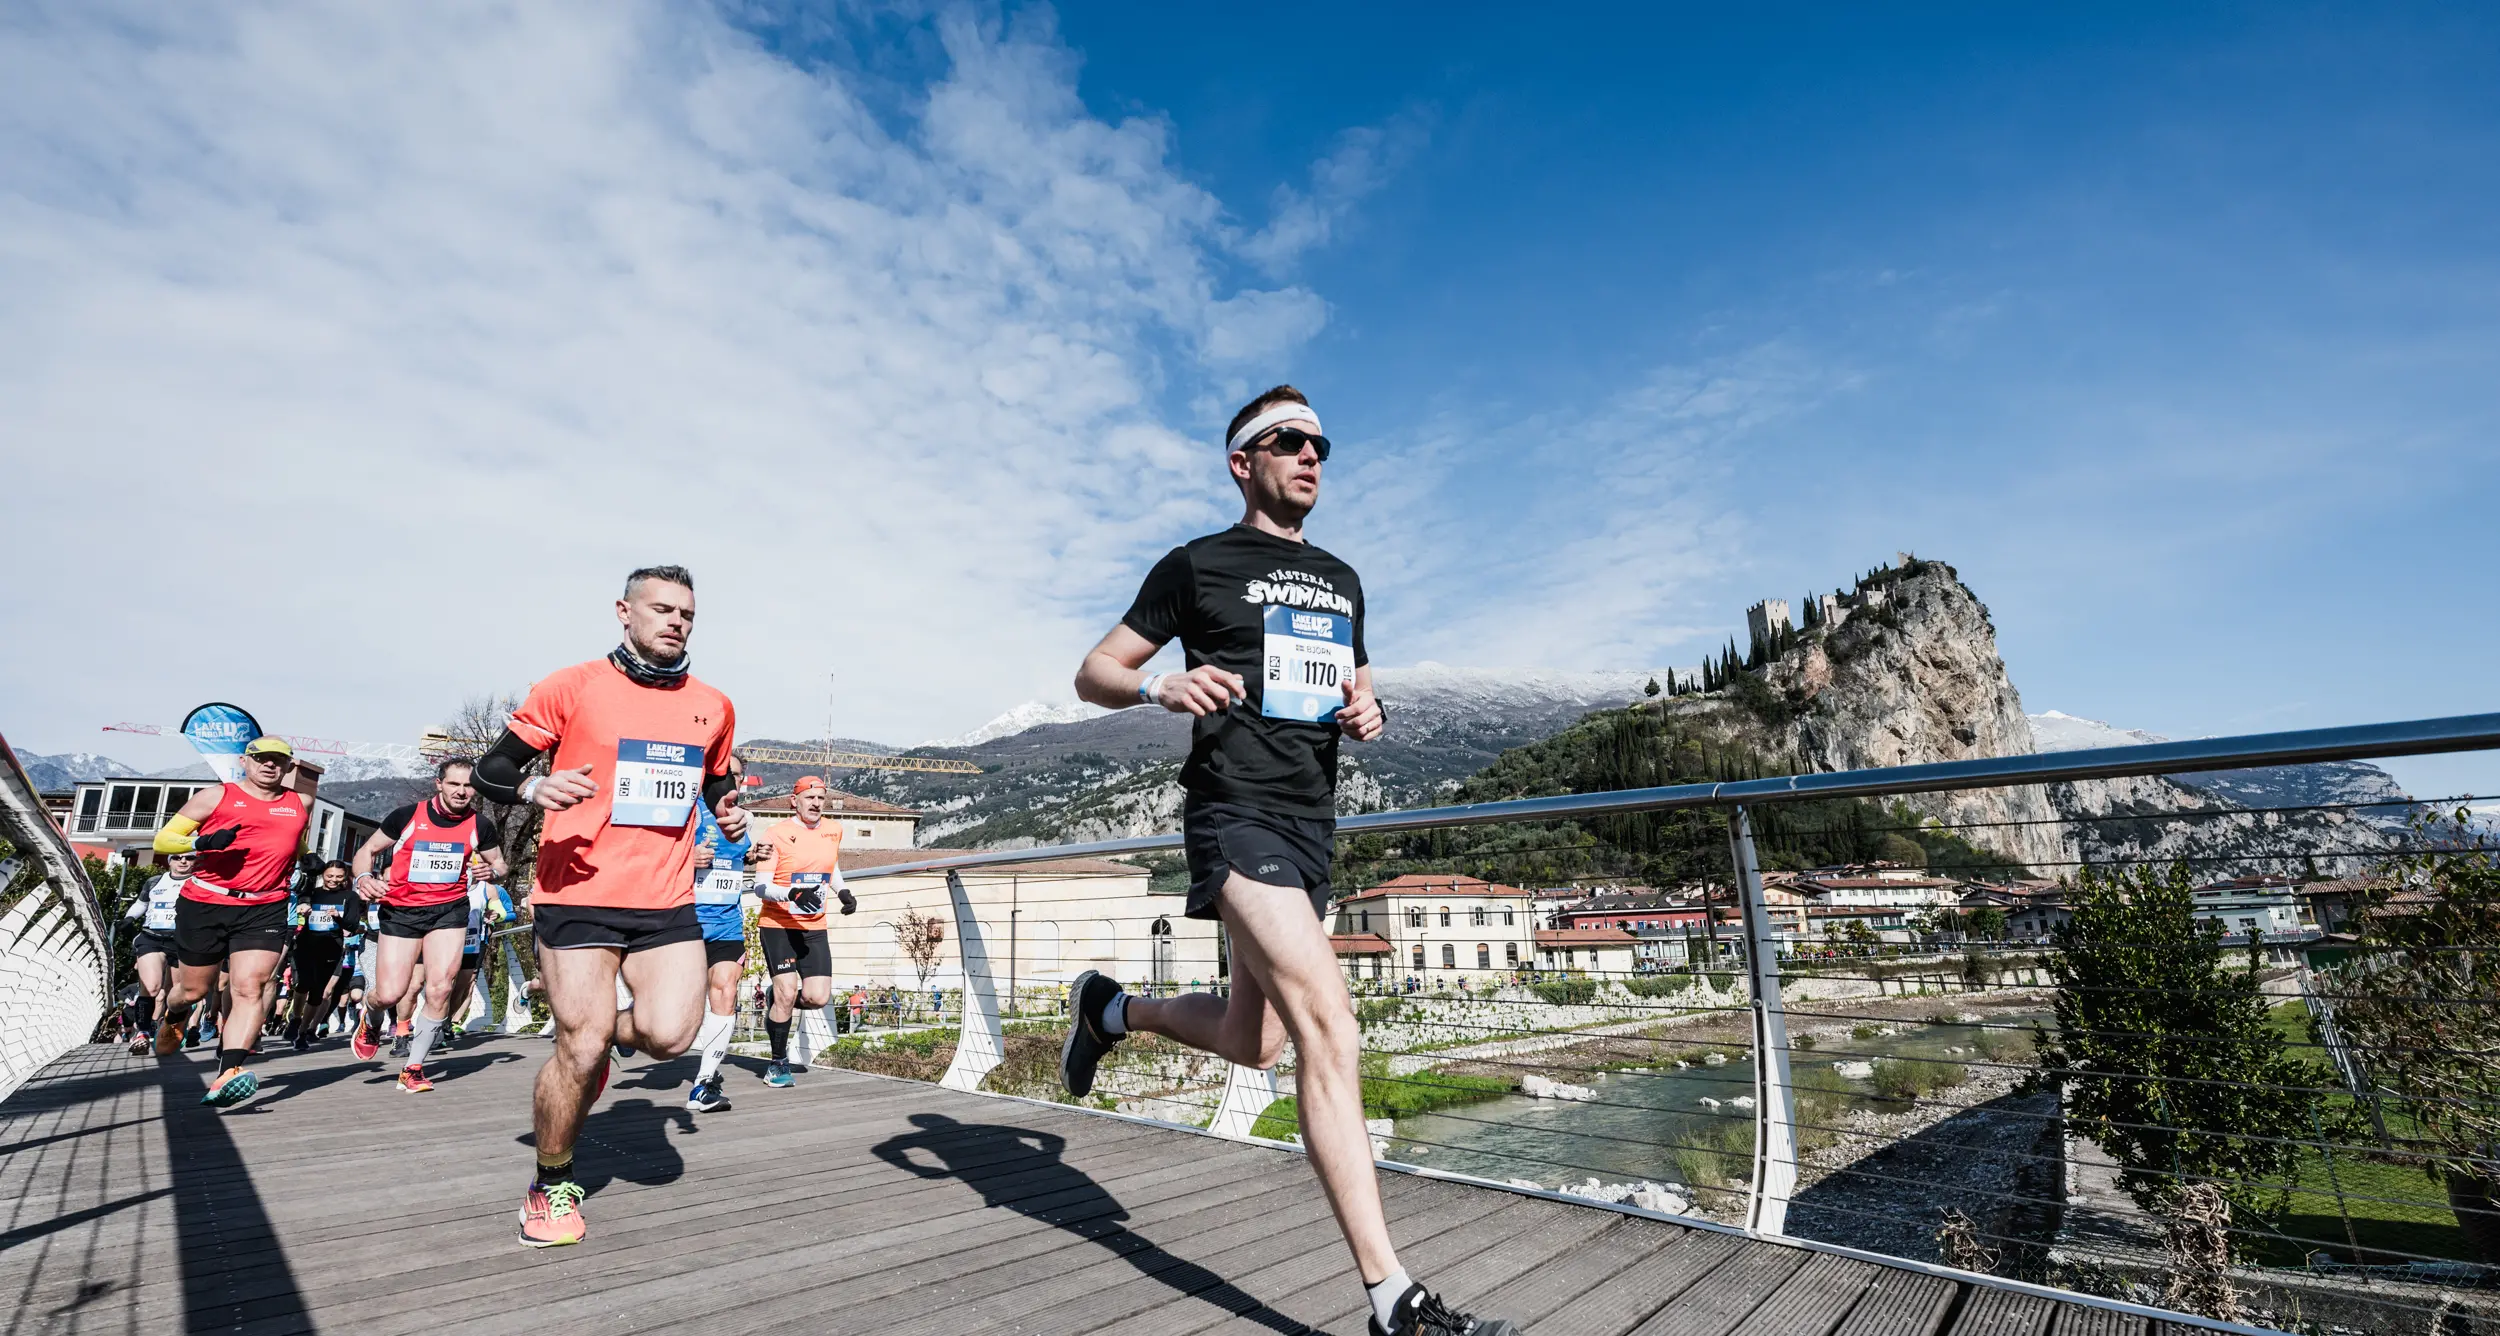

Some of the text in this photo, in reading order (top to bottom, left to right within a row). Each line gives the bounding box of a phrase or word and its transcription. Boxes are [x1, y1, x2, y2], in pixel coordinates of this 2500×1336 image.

[1291, 612, 1312, 623] LAKE
[194, 722, 222, 730] LAKE
[647, 743, 667, 752] LAKE
[656, 768, 683, 777] MARCO
[1258, 863, 1280, 875] dhb
